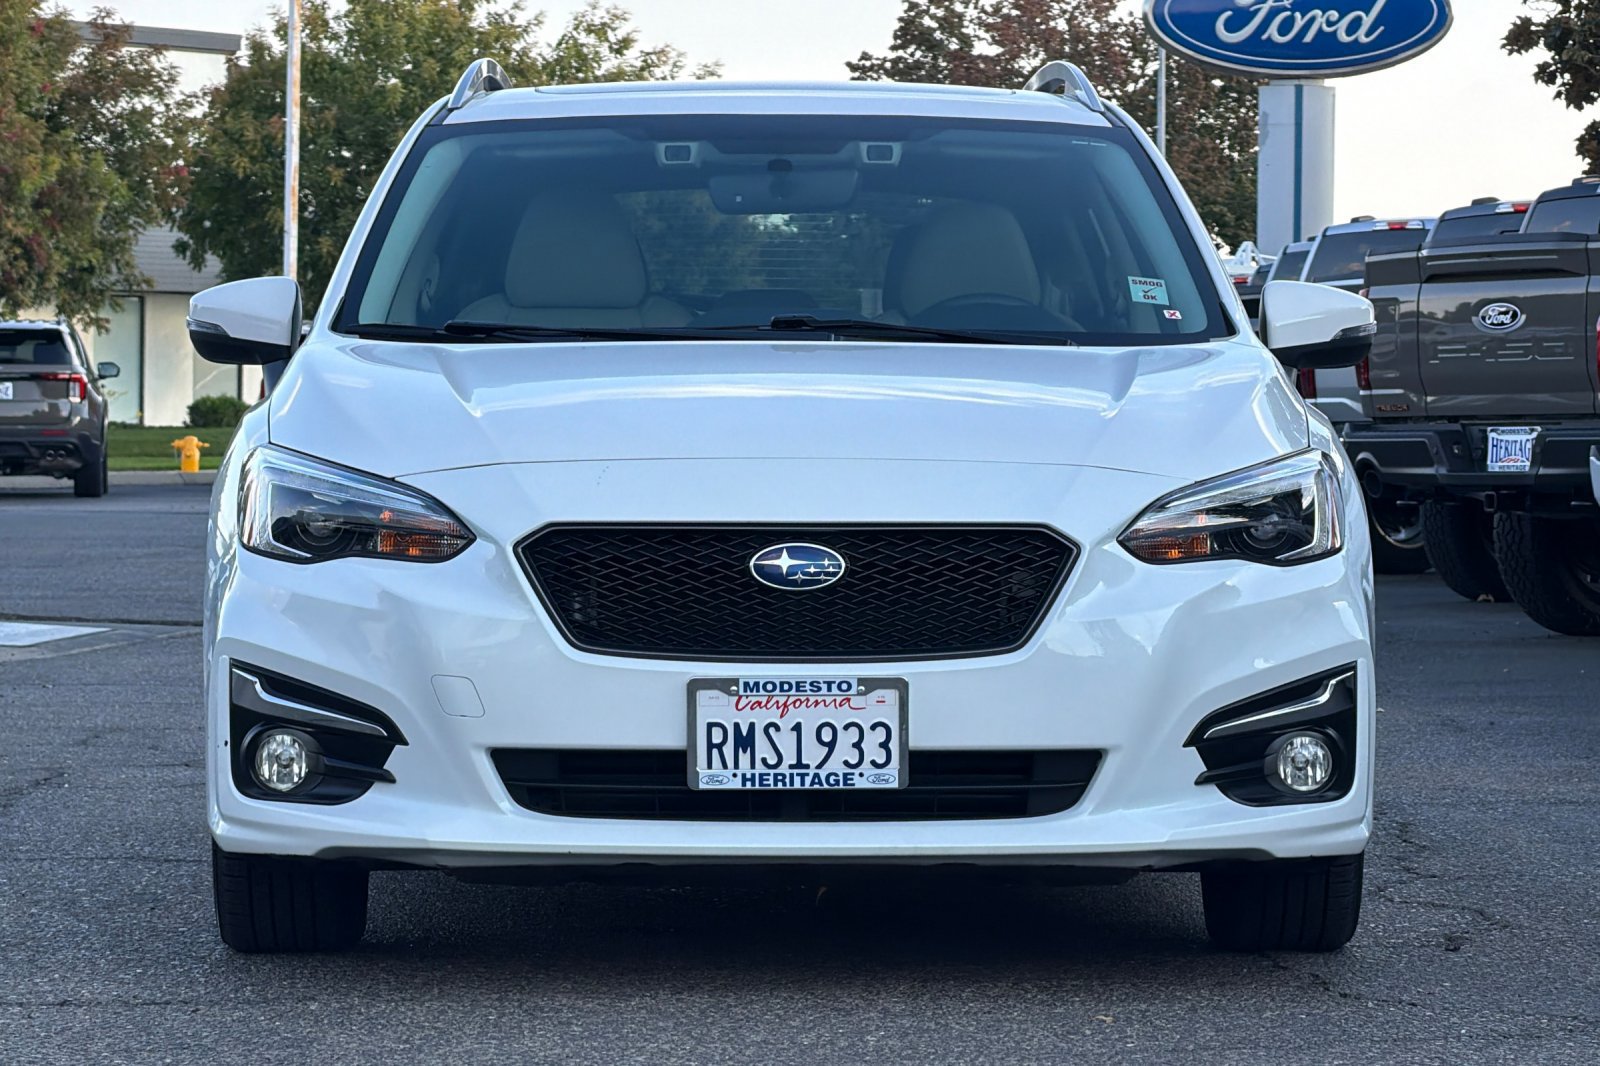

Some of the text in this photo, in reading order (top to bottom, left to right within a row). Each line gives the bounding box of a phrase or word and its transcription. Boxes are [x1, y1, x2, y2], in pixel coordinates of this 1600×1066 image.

[1215, 0, 1385, 43] Ford
[1131, 279, 1163, 288] SMOG
[1143, 293, 1158, 301] OK
[1485, 306, 1514, 324] Ford
[742, 680, 853, 693] MODESTO
[734, 694, 867, 719] California
[705, 721, 893, 770] RMS1933
[705, 774, 725, 785] Ford
[741, 772, 856, 788] HERITAGE
[871, 773, 891, 784] Ford
